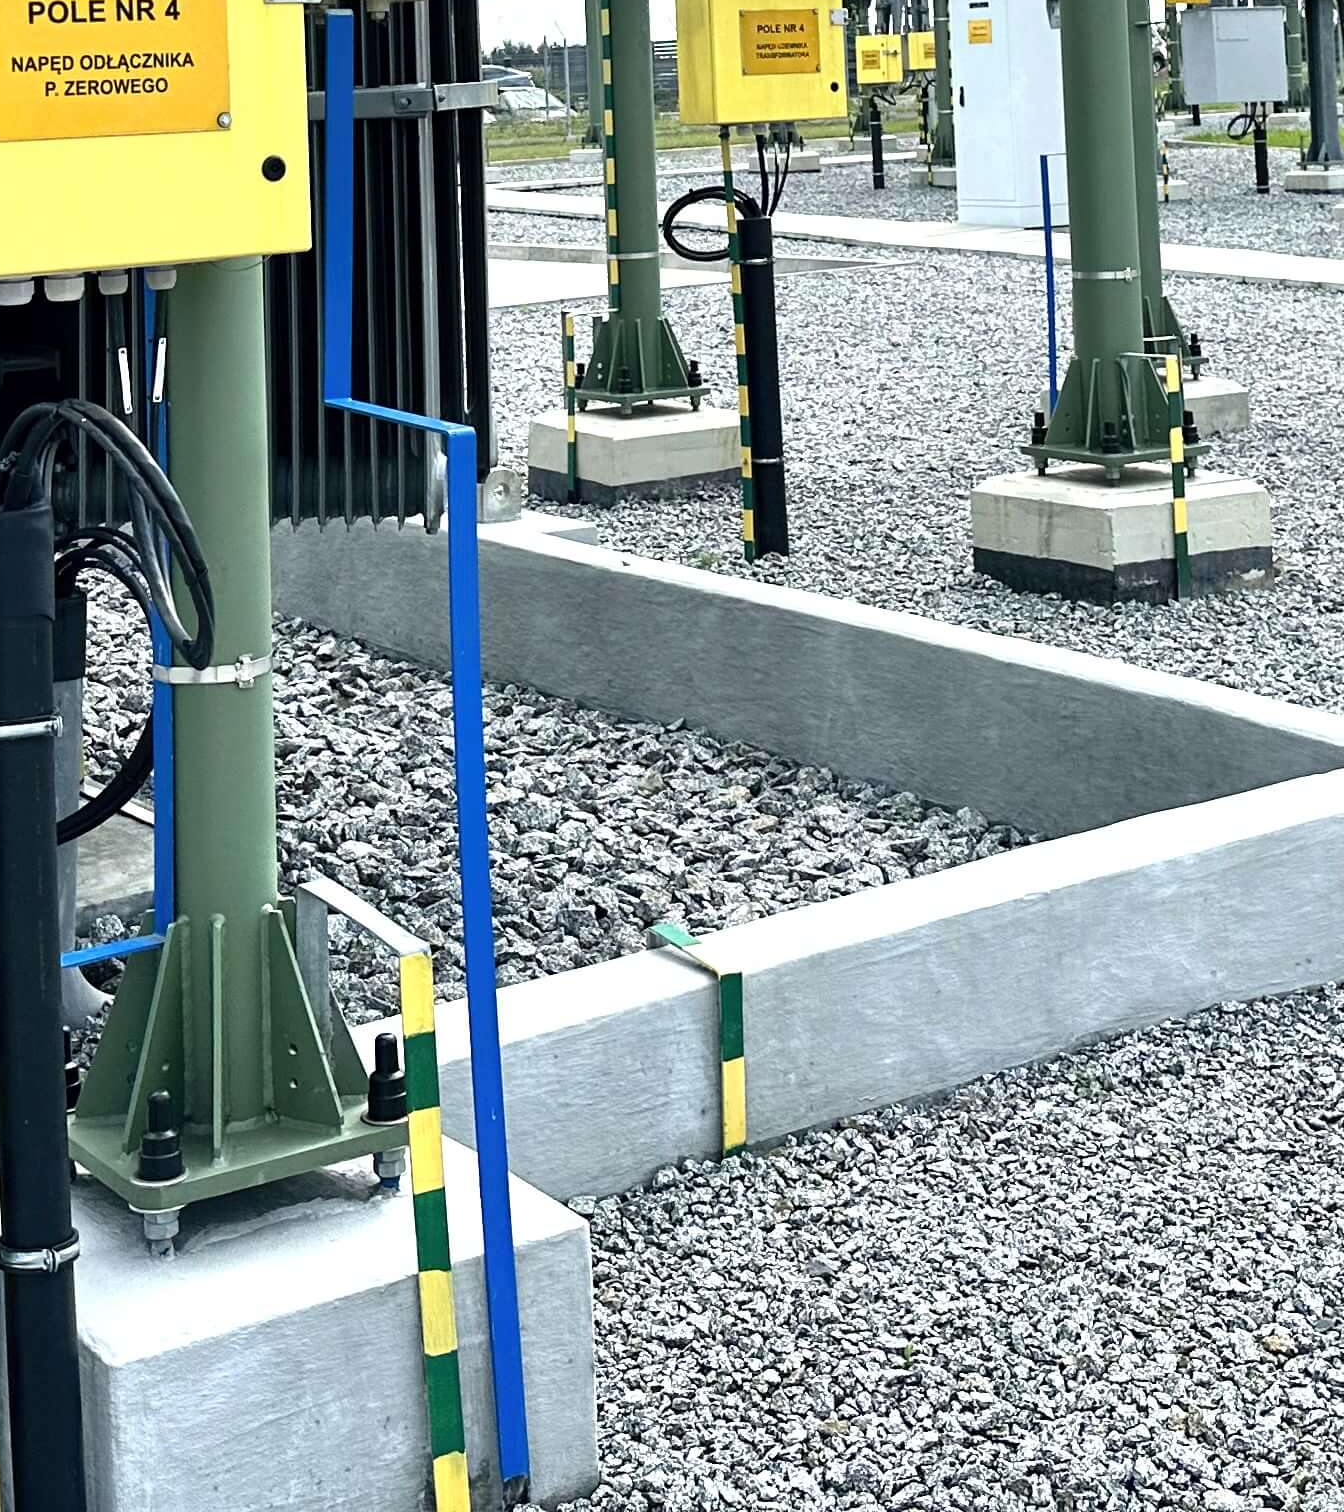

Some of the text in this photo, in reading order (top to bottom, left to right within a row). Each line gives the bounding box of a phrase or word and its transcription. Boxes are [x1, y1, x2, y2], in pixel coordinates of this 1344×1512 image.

[28, 0, 106, 24] POLE
[757, 23, 805, 33] POLE NR 4
[11, 52, 195, 75] NAPĘD ODŁĄCZNIKA
[45, 77, 169, 97] P. ZEROWEGO
